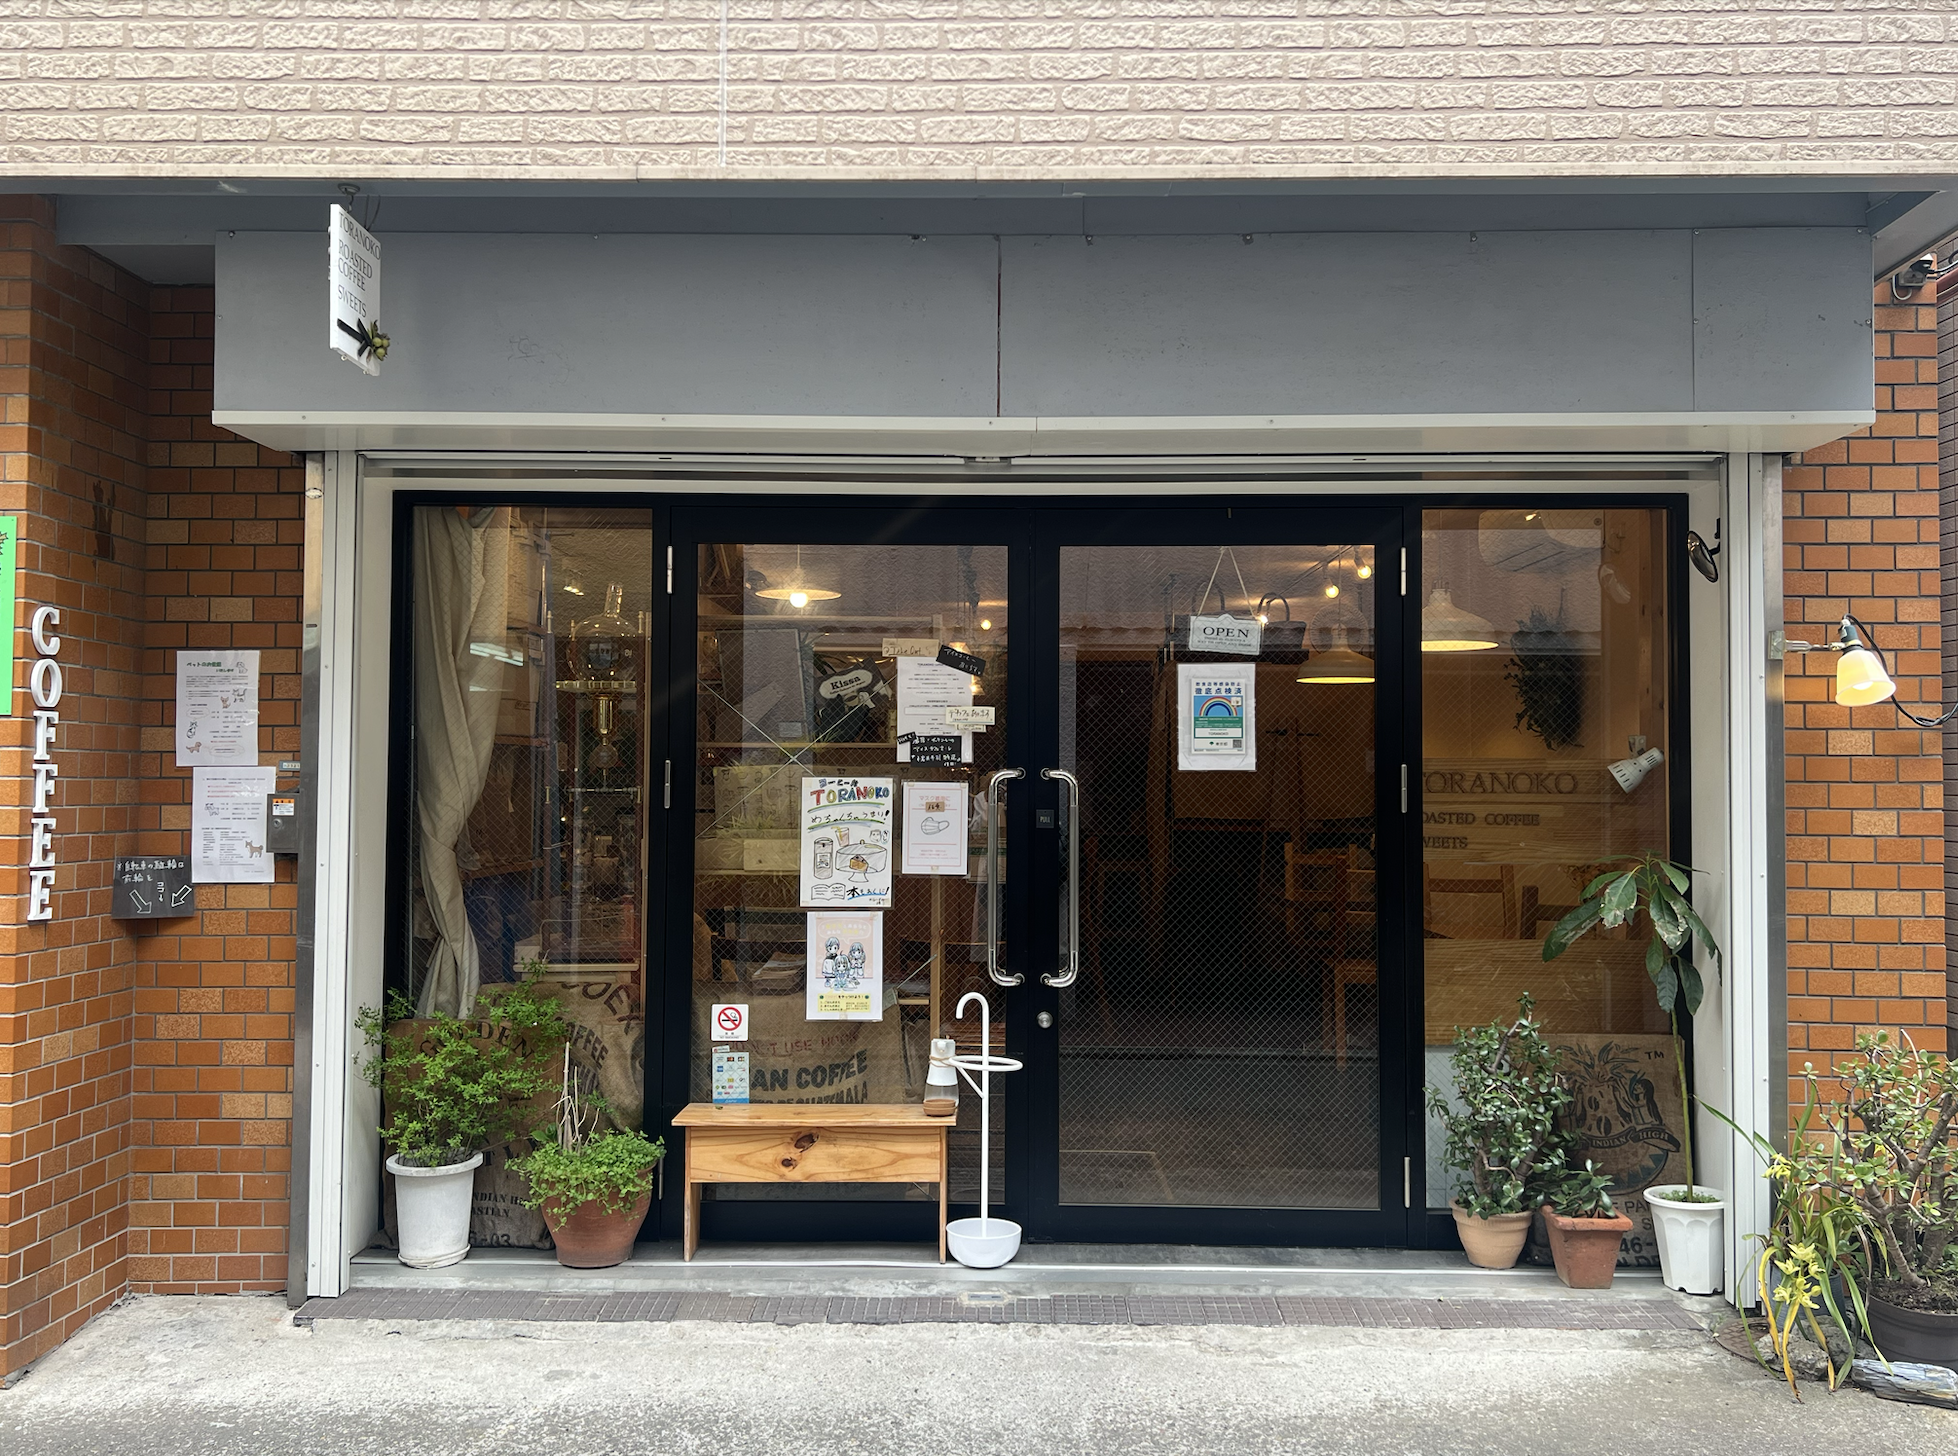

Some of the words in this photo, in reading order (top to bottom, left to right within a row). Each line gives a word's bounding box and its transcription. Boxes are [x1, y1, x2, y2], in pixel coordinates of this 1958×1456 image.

[339, 211, 381, 261] TORANOKO
[338, 239, 373, 279] ROASTED
[338, 258, 366, 292] COFFEE
[338, 284, 367, 318] SWEETS
[1203, 626, 1249, 638] OPEN
[830, 676, 861, 690] Kissa
[1194, 687, 1242, 695] 徹底点検済
[27, 605, 63, 921] COFFEE
[1423, 770, 1578, 795] ORANOKO
[810, 786, 890, 806] TORANOKO
[1040, 815, 1051, 823] PULL
[1423, 811, 1476, 826] OASTED
[1484, 812, 1540, 826] COFFEE
[1423, 836, 1468, 849] WEETS
[1645, 1051, 1665, 1060] TM
[796, 1049, 868, 1090] COFFEE
[1591, 1136, 1627, 1147] INDIAN
[1639, 1131, 1669, 1141] HIGH
